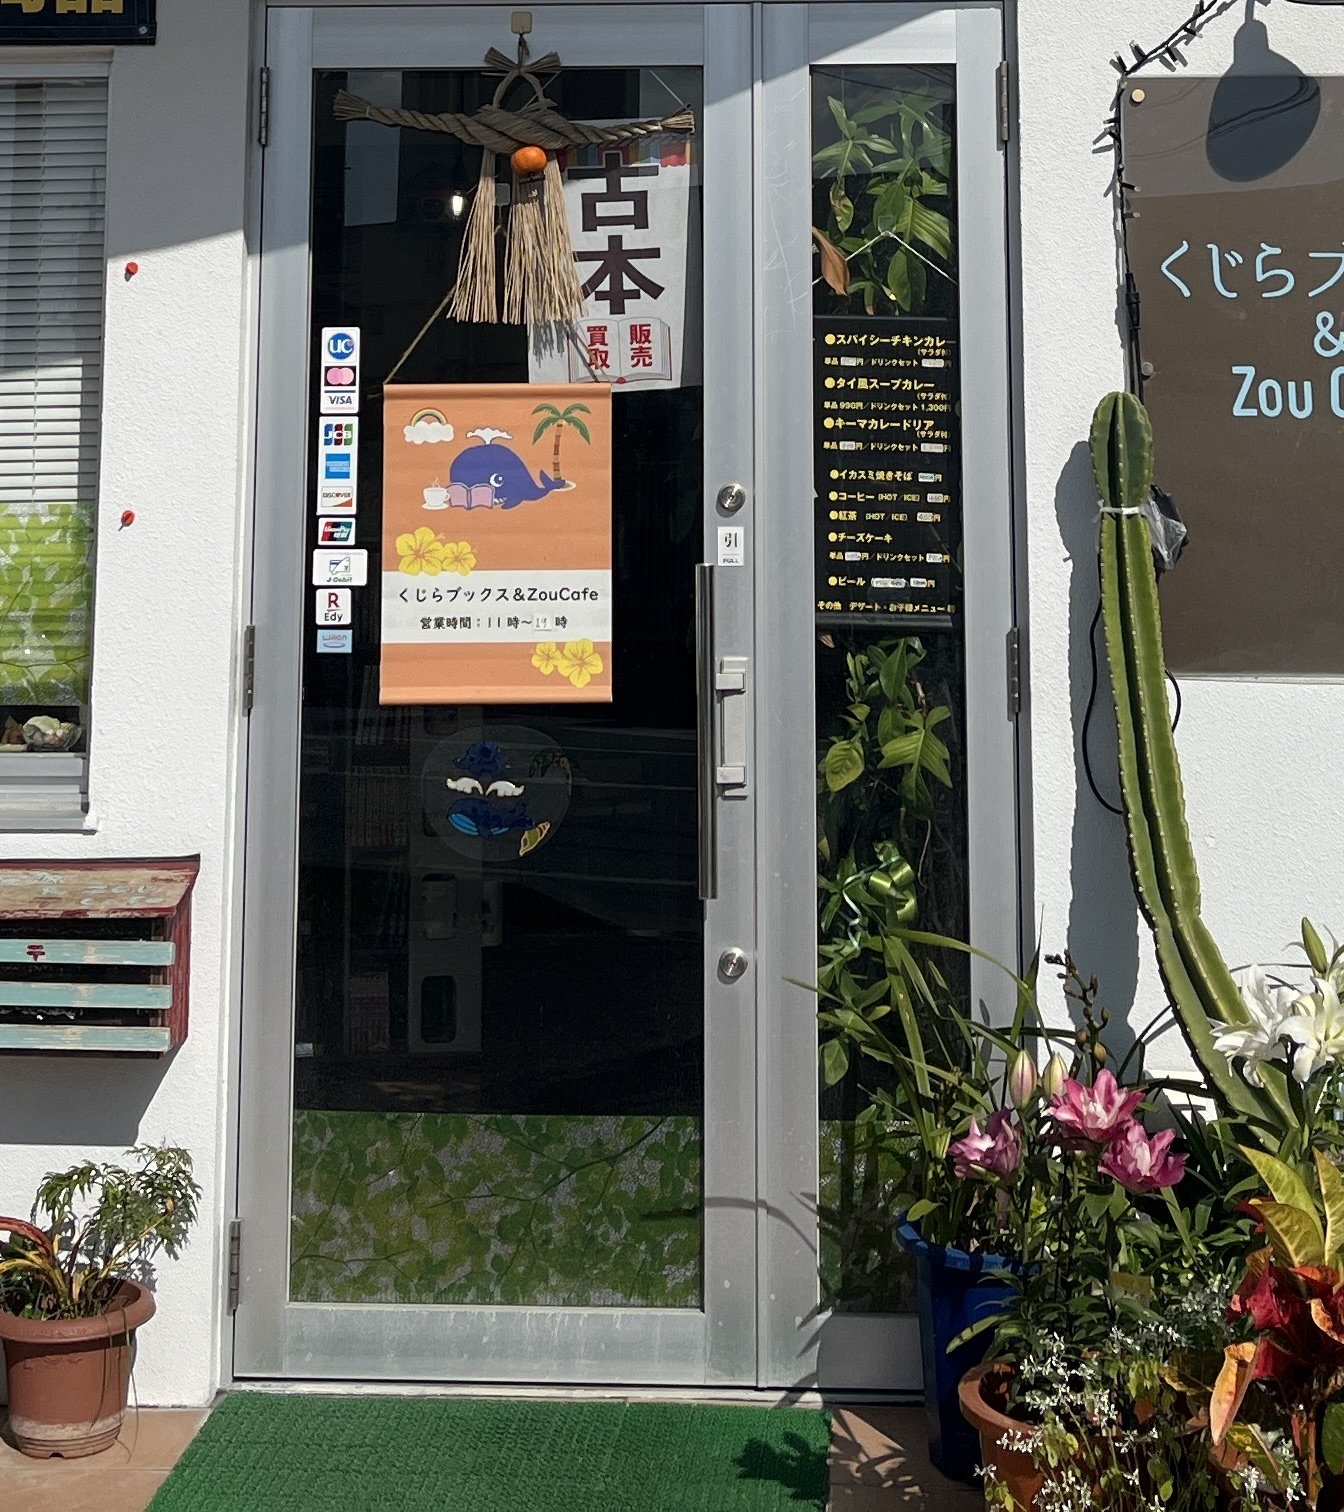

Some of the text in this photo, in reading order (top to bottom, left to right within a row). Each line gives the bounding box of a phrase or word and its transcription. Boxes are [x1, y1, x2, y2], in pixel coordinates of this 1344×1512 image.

[567, 151, 666, 316] 古本
[329, 338, 354, 354] UC
[586, 325, 611, 370] 買取
[629, 323, 654, 368] 販売
[328, 395, 352, 405] VISA
[1231, 365, 1314, 419] Zou
[724, 532, 738, 548] 引
[838, 533, 893, 543] チーズケーキ
[838, 576, 866, 587] ビール
[327, 592, 340, 608] R
[324, 612, 343, 622] Edy
